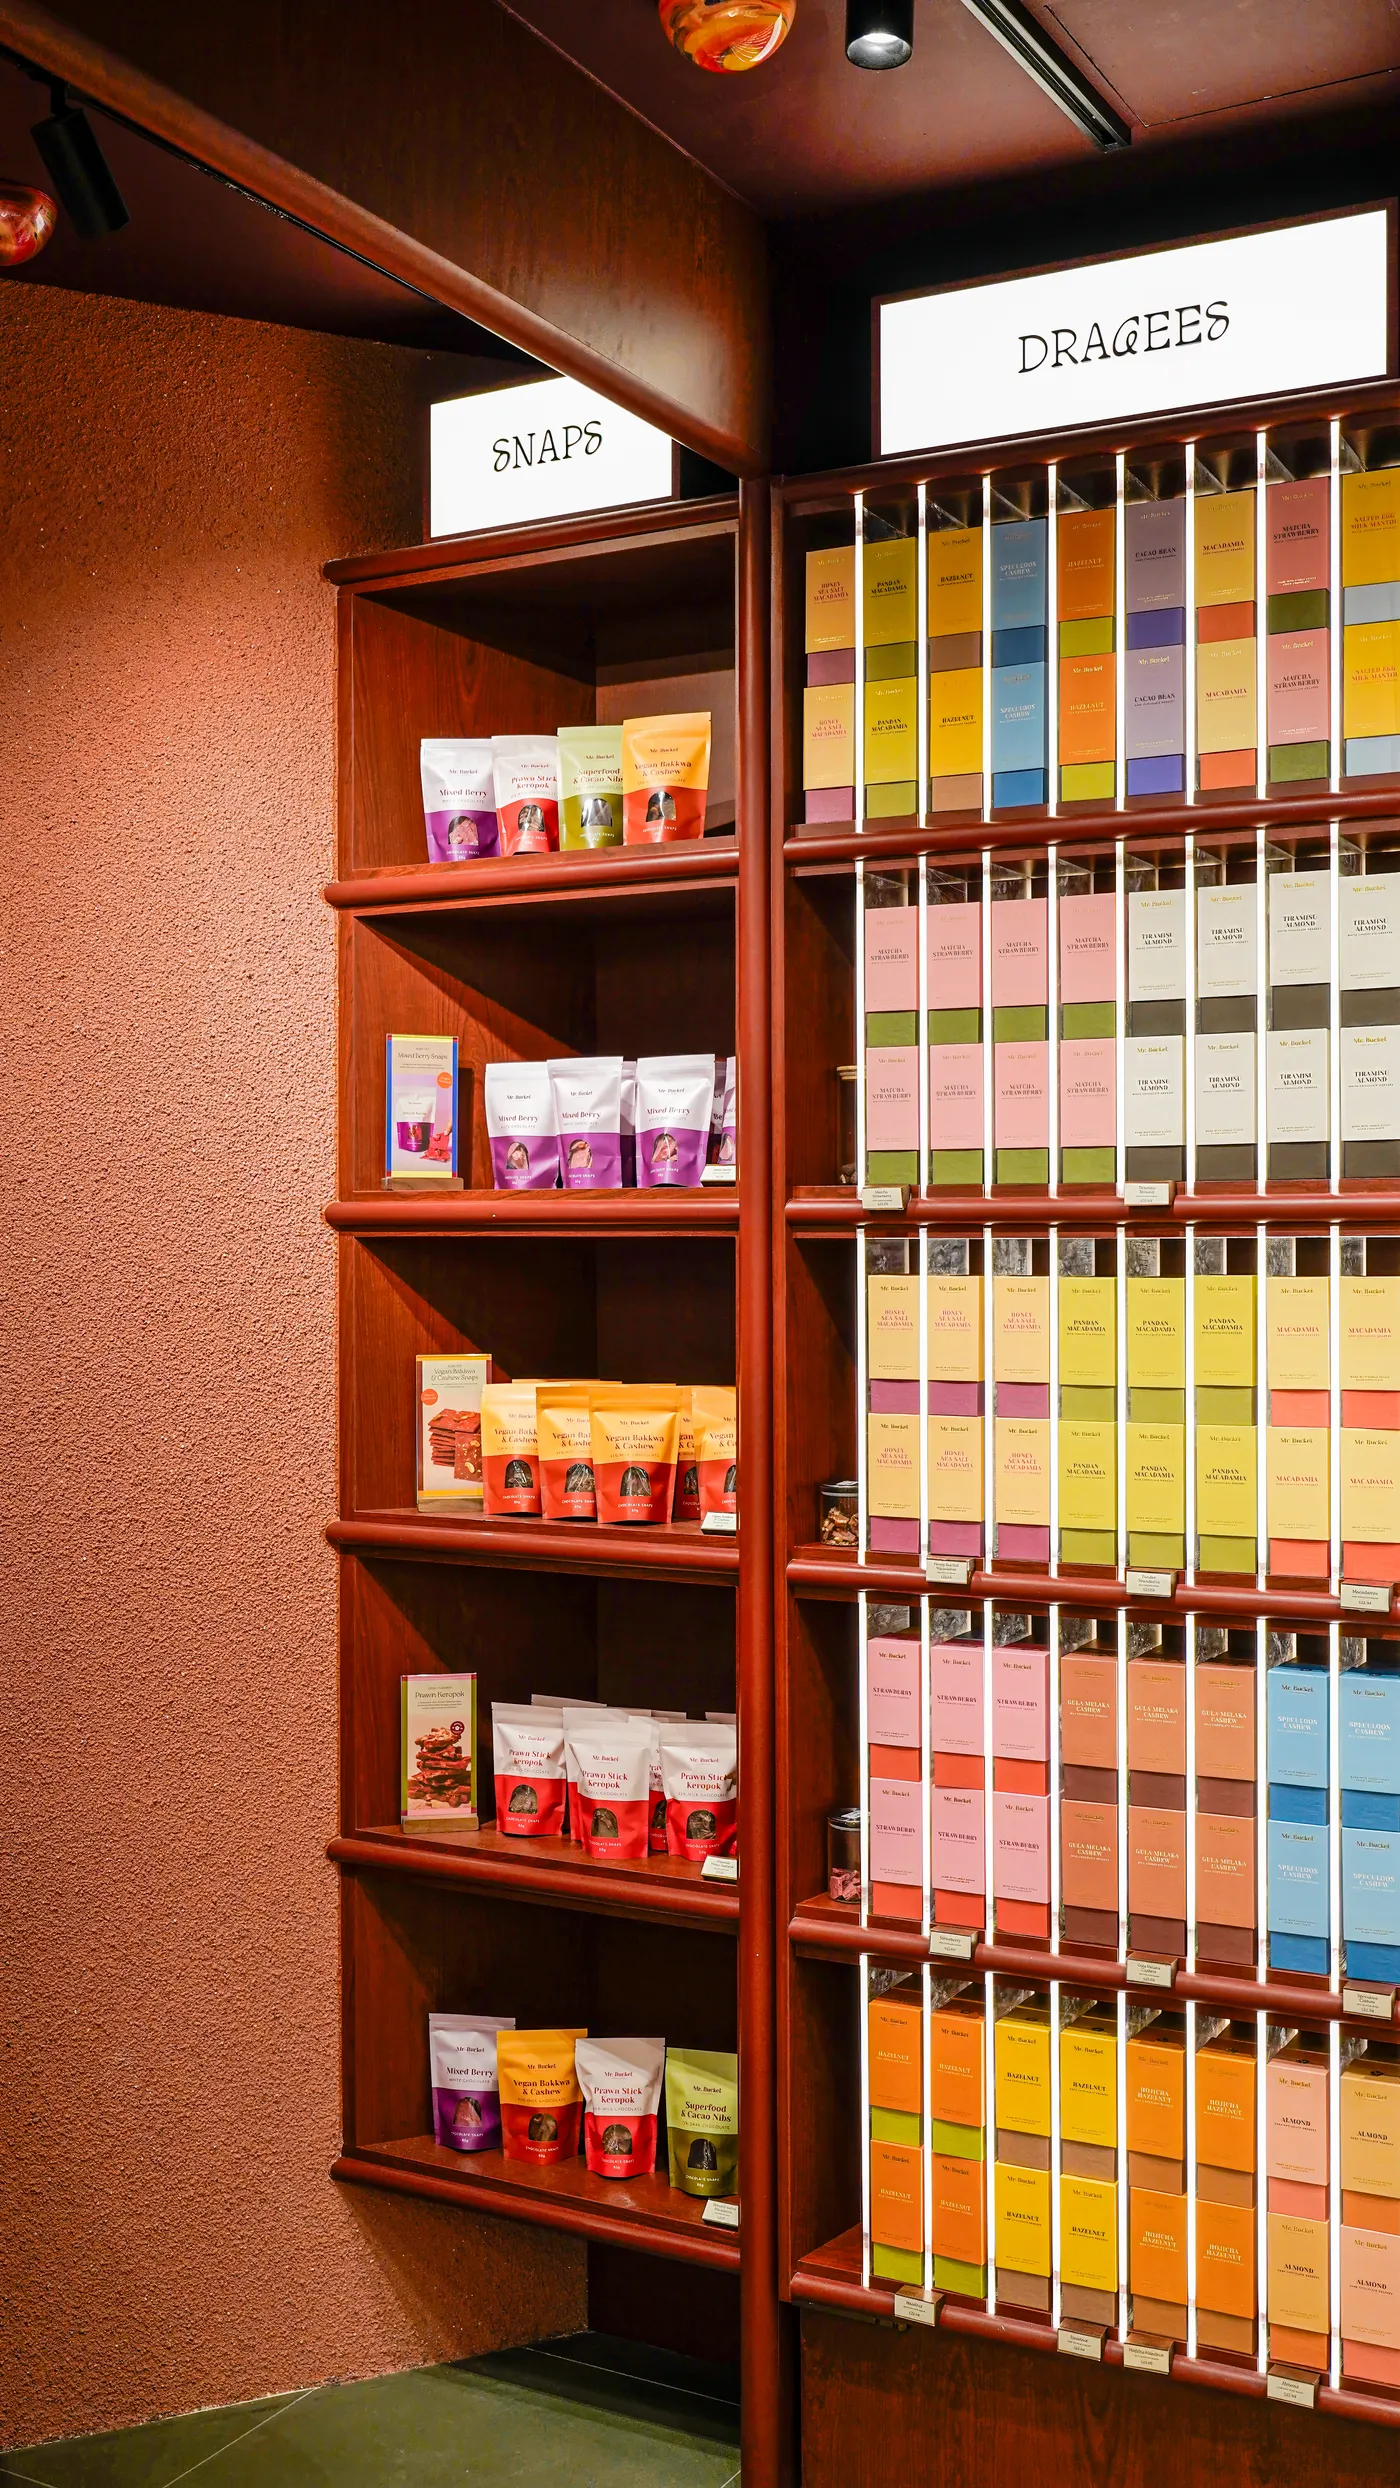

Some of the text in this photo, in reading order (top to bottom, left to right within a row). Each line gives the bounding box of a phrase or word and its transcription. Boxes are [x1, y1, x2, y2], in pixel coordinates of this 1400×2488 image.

[1018, 300, 1230, 375] DRAGEES
[492, 420, 603, 473] SNAPS
[1282, 523, 1311, 531] MATCHA
[1273, 528, 1320, 540] STRAWBERRY
[1203, 540, 1245, 551] MACADAMIA
[1135, 547, 1176, 558] CACAO BEAN
[940, 574, 973, 583] HAZELNUT
[1283, 674, 1312, 682] MATCHA
[1274, 678, 1320, 689] STRAWBERRY
[1206, 688, 1247, 698] MACADAMIA
[942, 715, 975, 724] HAZELNUT
[579, 768, 620, 776] Superfood
[465, 789, 487, 798] Berry
[1284, 914, 1317, 922] TIRAMISU
[1354, 918, 1388, 926] TIRAMISU
[1286, 919, 1315, 927] ALMOND
[1356, 923, 1386, 932] ALMOND
[1067, 942, 1109, 950] STRAWBERRY
[871, 953, 910, 961] STRAWBERRY
[1354, 1070, 1389, 1078] TIRAMISU
[1357, 1075, 1387, 1083] ALMOND
[669, 1107, 690, 1115] Berry
[519, 1115, 539, 1123] Berry
[1276, 1475, 1319, 1483] MACADAMIA
[438, 1691, 464, 1699] Keropok
[873, 1687, 912, 1696] STRAWBERRY
[997, 1699, 1037, 1707] STRAWBERRY
[532, 1750, 551, 1758] Stick
[514, 1758, 543, 1766] Keropok
[582, 1771, 606, 1779] Prawn
[681, 1773, 706, 1781] Prawn
[588, 1780, 620, 1789] Keropok
[687, 1782, 721, 1791] Keropok
[938, 1831, 977, 1840] STRAWBERRY
[878, 2051, 909, 2061] HAZELNUT
[447, 2067, 494, 2078] Mixed Berry
[1007, 2072, 1039, 2082] HAZELNUT
[602, 2096, 635, 2104] Keropok
[686, 2102, 726, 2112] Superfood
[713, 2113, 731, 2122] Nibs
[1281, 2117, 1311, 2127] ALMOND
[1357, 2131, 1388, 2140] ALMOND
[1007, 2211, 1039, 2221] HAZELNUT
[1284, 2263, 1314, 2273] ALMOND
